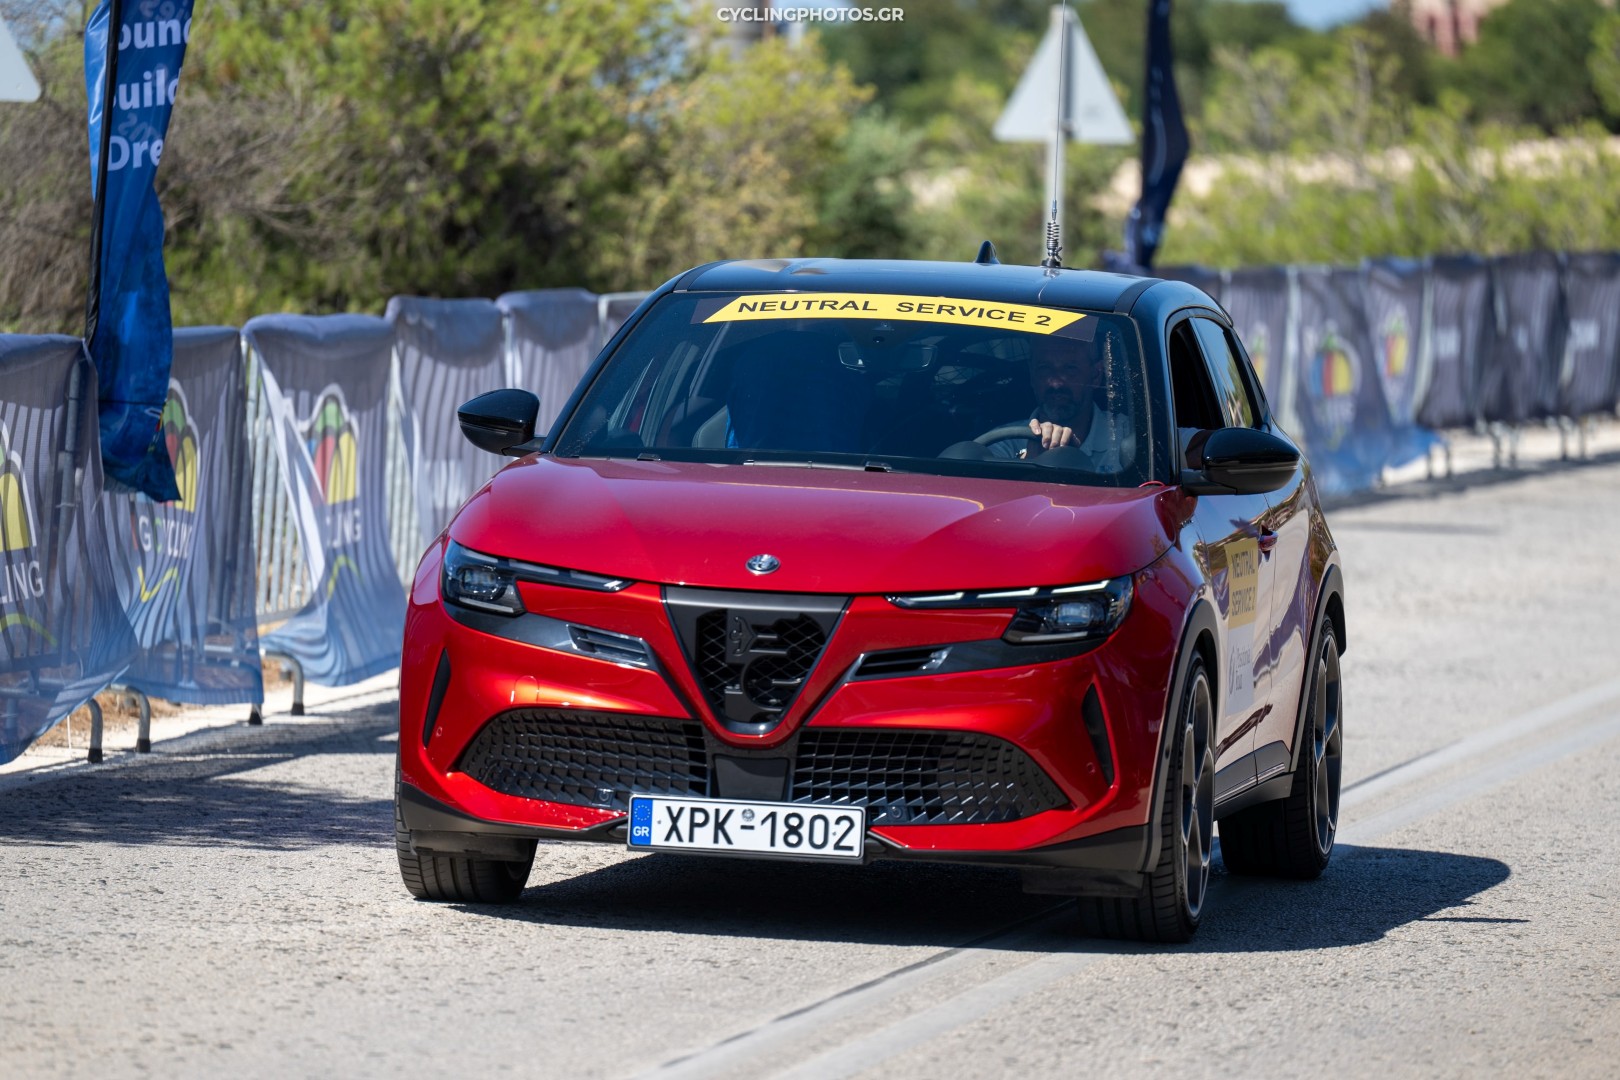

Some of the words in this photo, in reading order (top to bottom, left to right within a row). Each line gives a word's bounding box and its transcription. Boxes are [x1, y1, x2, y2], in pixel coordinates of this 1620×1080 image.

[738, 299, 878, 313] NEUTRAL
[896, 301, 1027, 323] SERVICE
[1034, 314, 1052, 327] 2
[1231, 549, 1256, 579] NEUTRAL
[632, 826, 650, 838] GR
[664, 805, 856, 851] XPK-1802
